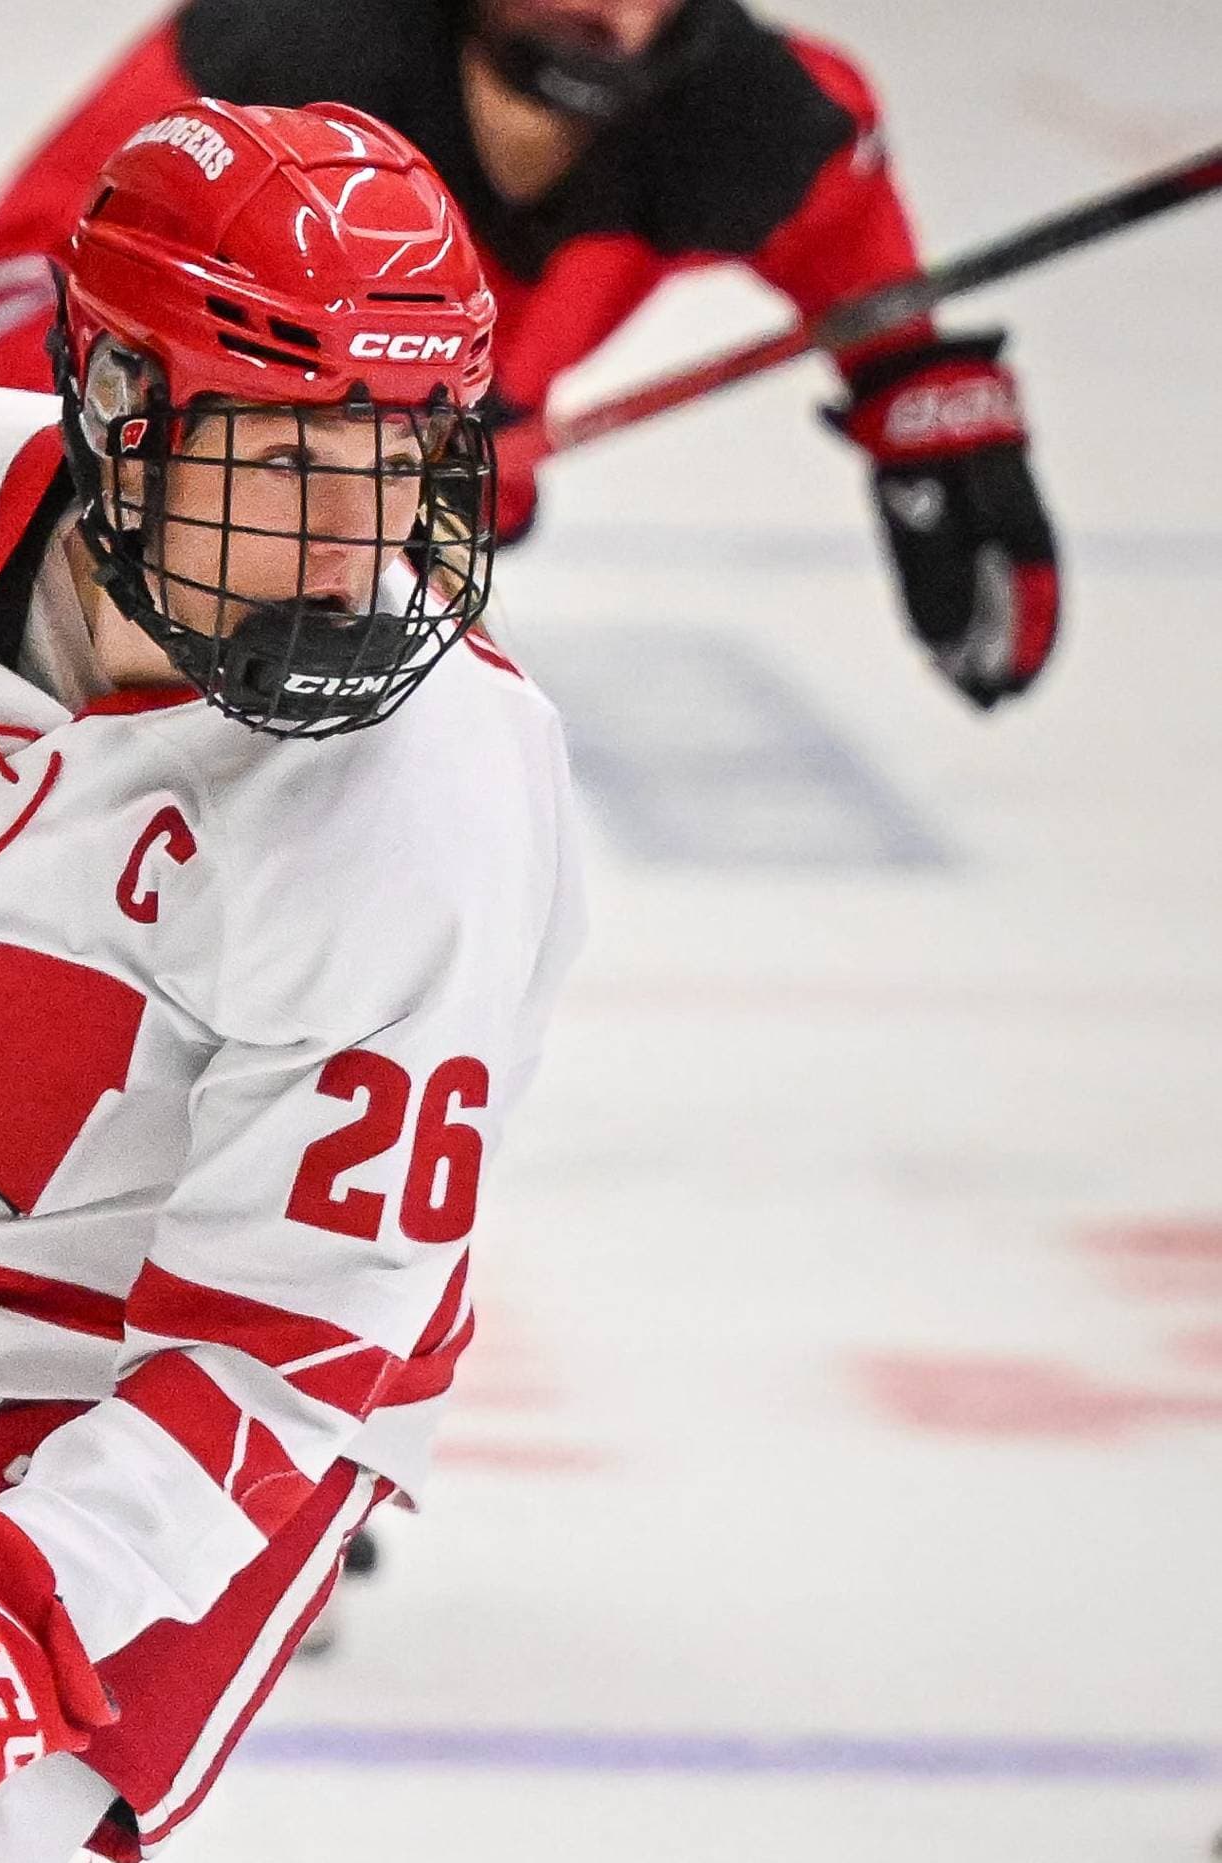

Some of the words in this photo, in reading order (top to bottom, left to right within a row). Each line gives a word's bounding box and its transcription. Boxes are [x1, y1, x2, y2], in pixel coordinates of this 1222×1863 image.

[348, 333, 463, 360] CCM
[116, 805, 197, 924] C
[285, 1048, 490, 1245] 26
